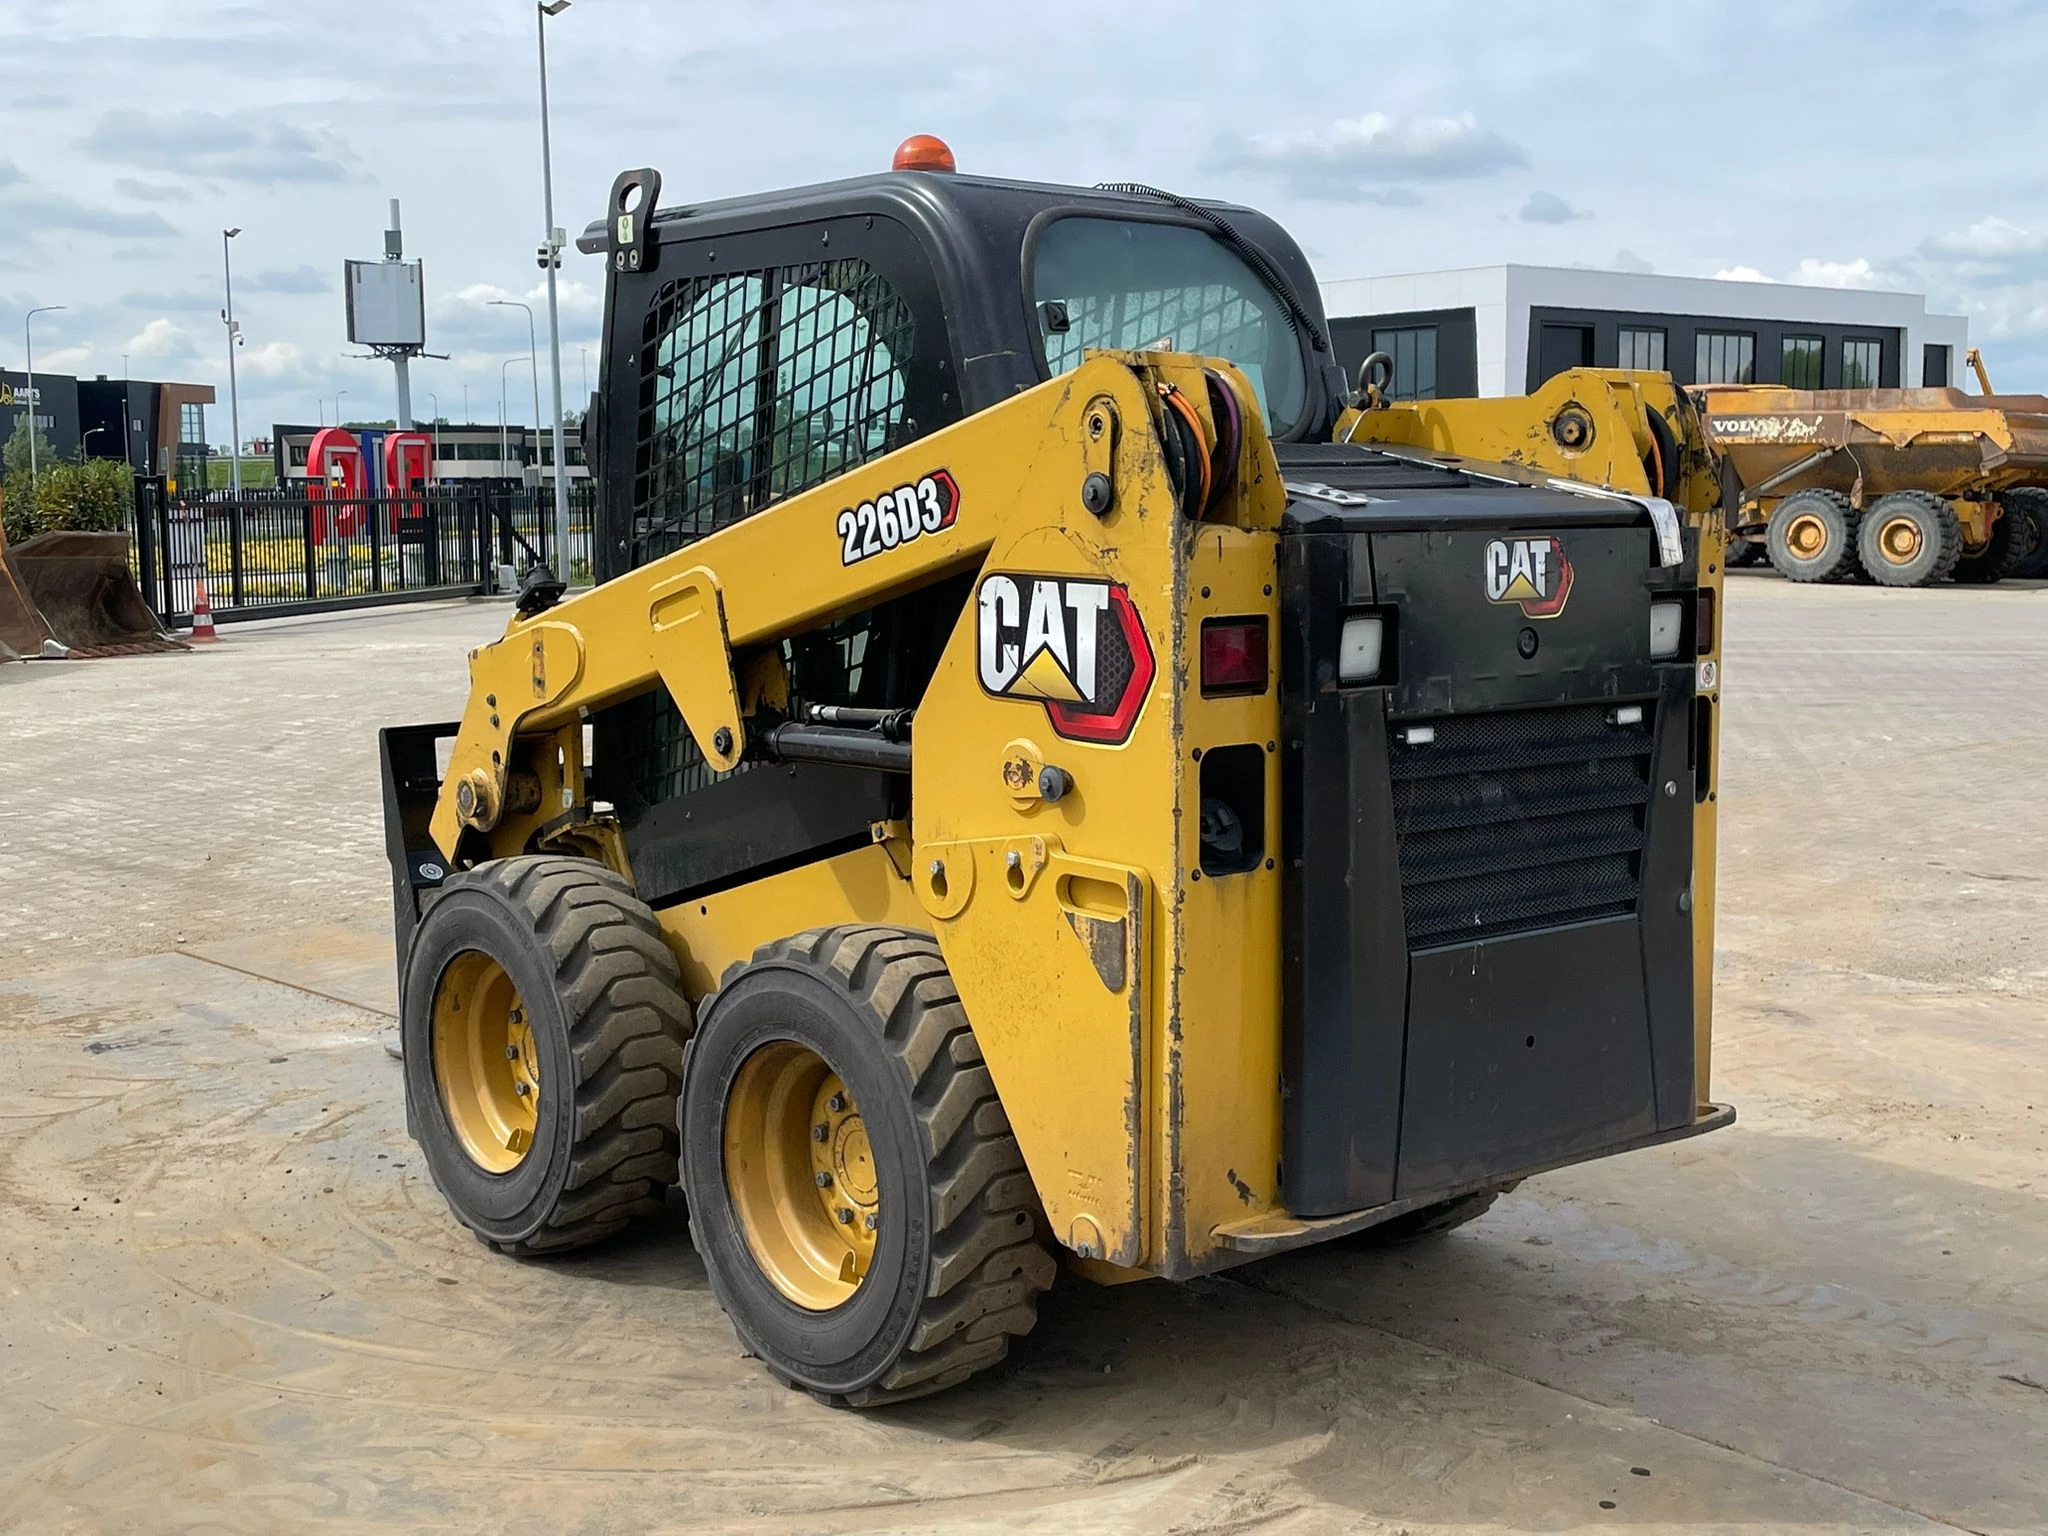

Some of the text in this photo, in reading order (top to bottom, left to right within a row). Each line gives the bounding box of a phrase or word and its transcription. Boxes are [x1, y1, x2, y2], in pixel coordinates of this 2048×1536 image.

[838, 478, 942, 566] 226D3
[1486, 541, 1551, 599] CAT
[979, 576, 1110, 703] CAT
